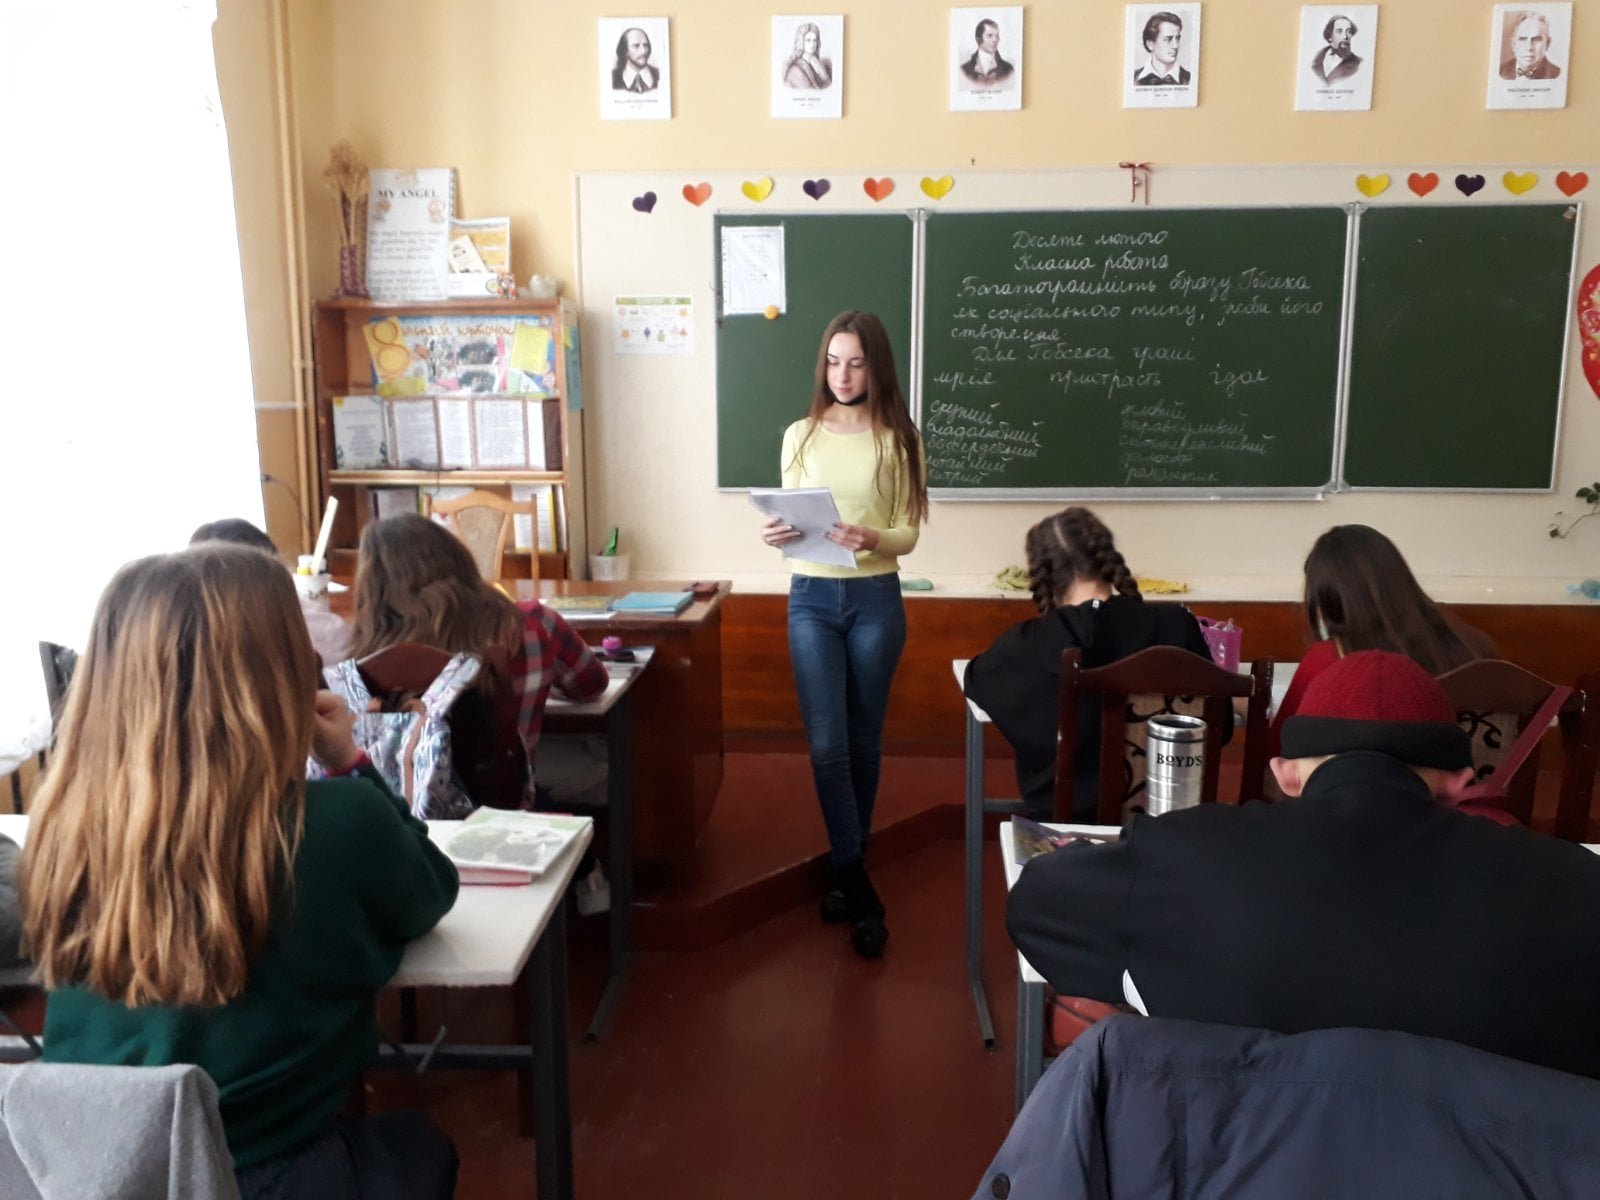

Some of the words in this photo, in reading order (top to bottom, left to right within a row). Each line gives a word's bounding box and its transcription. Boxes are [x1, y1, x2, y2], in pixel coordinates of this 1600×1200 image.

[378, 188, 396, 199] MY
[400, 187, 439, 199] ANGEL
[1095, 231, 1168, 246] лютого
[1014, 253, 1096, 271] Класна
[1102, 250, 1169, 279] робота
[1169, 269, 1232, 303] образу
[1280, 296, 1323, 315] його
[1156, 753, 1203, 767] BOYD'S
